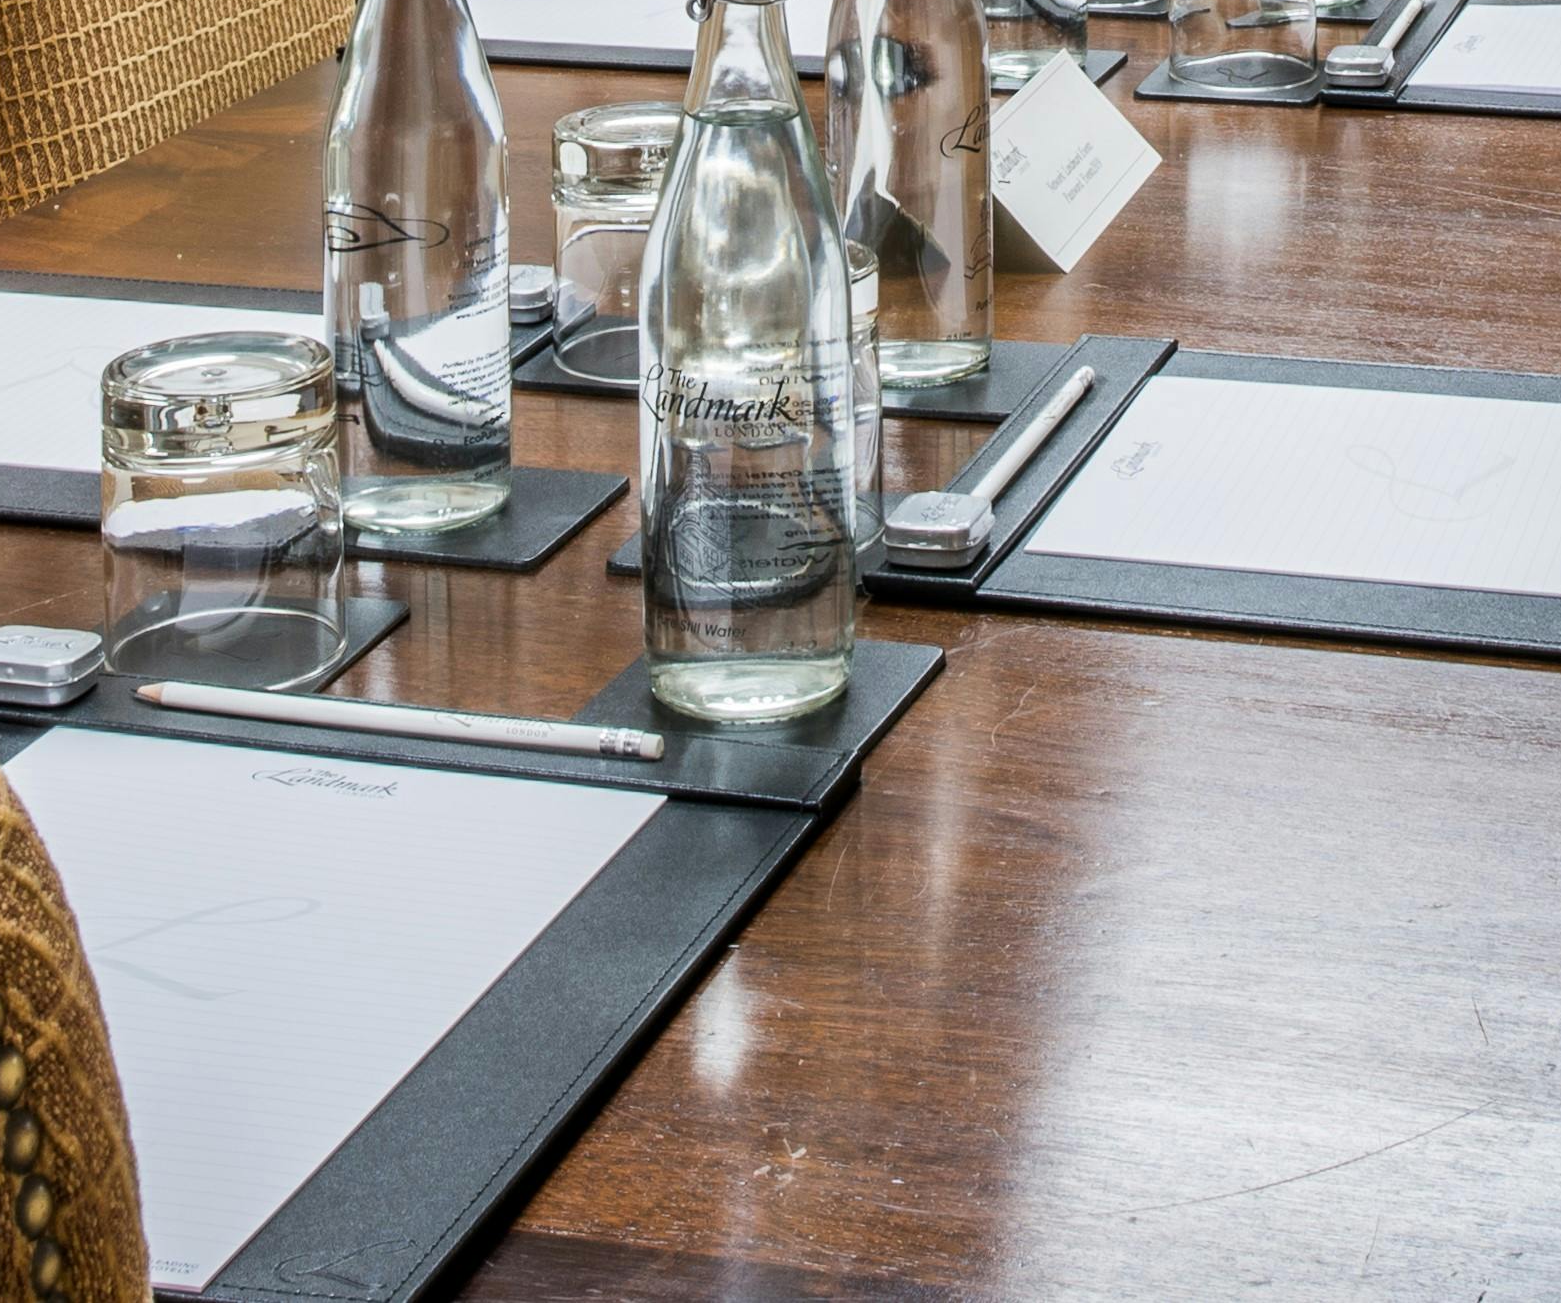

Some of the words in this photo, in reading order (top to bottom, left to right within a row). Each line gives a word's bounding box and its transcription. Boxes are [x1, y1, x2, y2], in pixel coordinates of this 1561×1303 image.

[667, 367, 697, 389] The
[641, 362, 799, 423] Landmark
[680, 619, 701, 634] Still
[705, 624, 747, 639] Water
[506, 726, 549, 738] LONDON
[252, 767, 398, 797] Landmark
